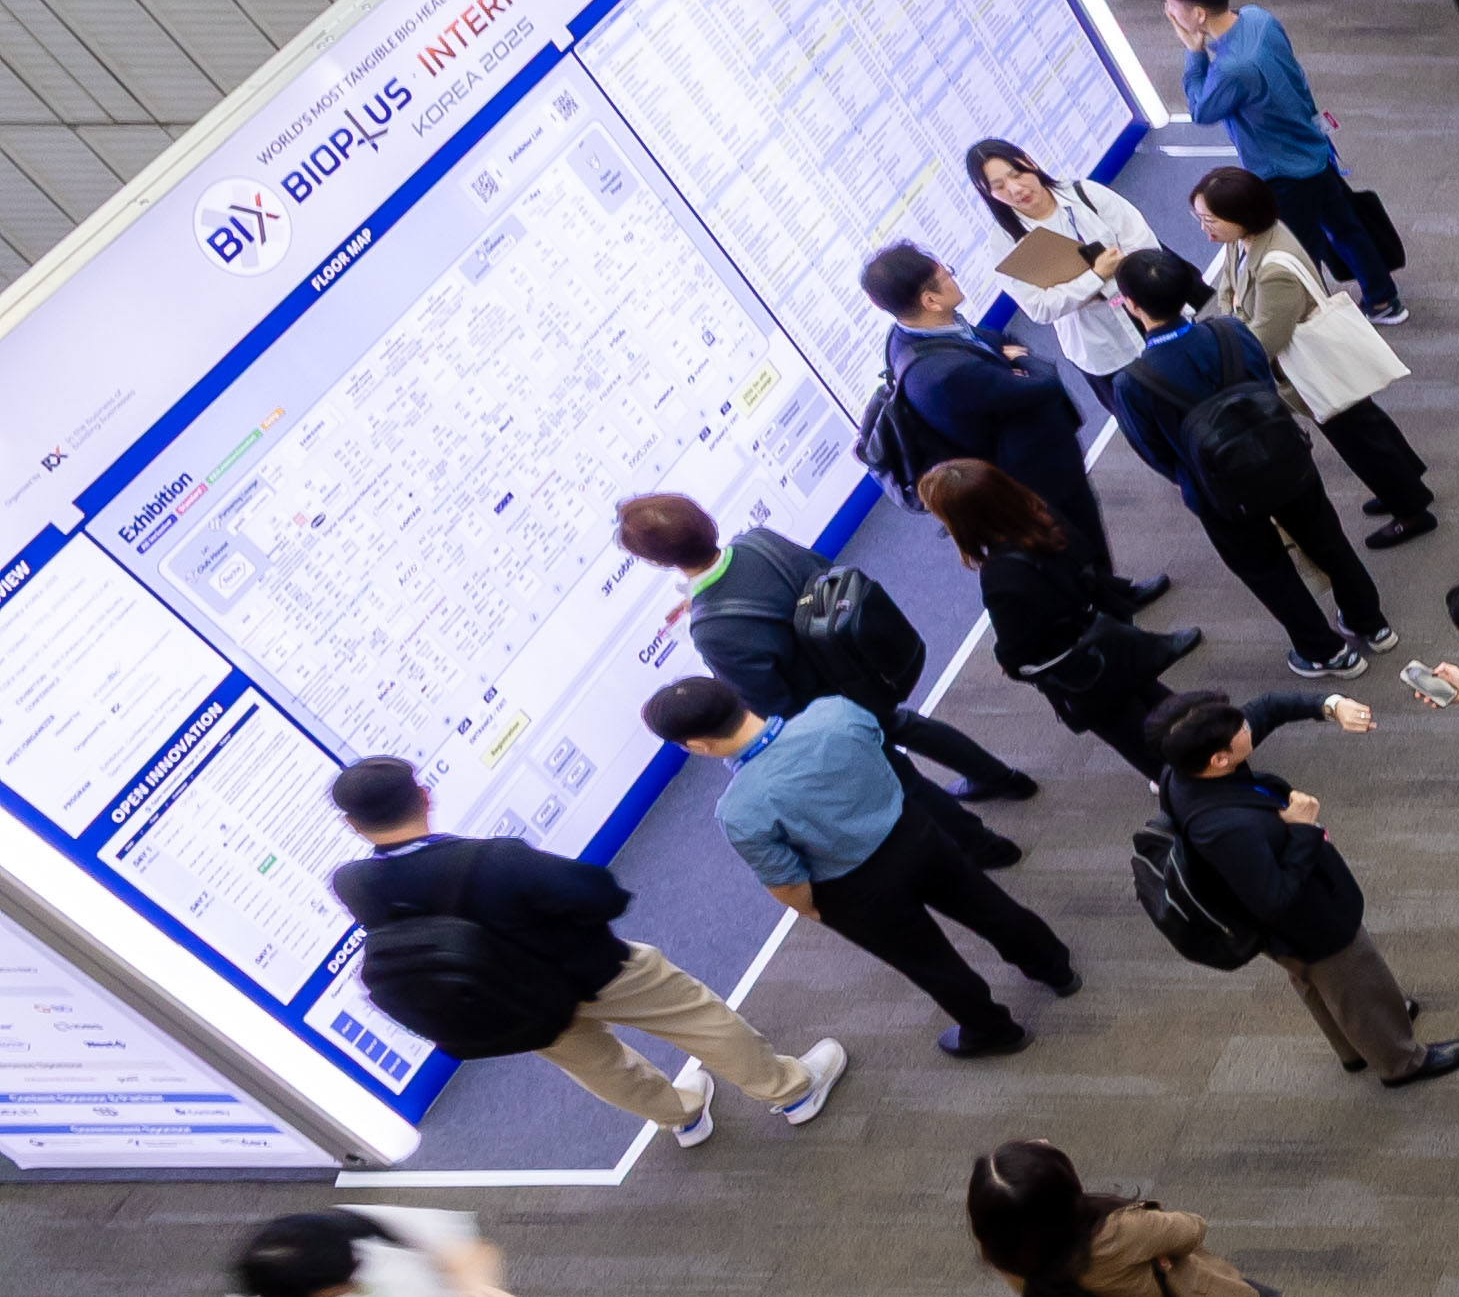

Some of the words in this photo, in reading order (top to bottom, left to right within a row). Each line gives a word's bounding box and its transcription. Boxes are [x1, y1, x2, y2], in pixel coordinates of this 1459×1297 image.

[308, 83, 345, 119] MOST
[341, 34, 398, 90] TANGIBLE
[411, 68, 483, 138] KOREA
[481, 16, 535, 72] 2025
[280, 78, 412, 205] BIOPLUS
[206, 191, 280, 262] BIX
[311, 246, 353, 292] FLOOR
[346, 227, 373, 260] MAP
[118, 472, 193, 544] Exhibition
[111, 782, 150, 824] OPEN
[144, 702, 224, 788] INNOVATION
[327, 927, 368, 975] DOCEN
